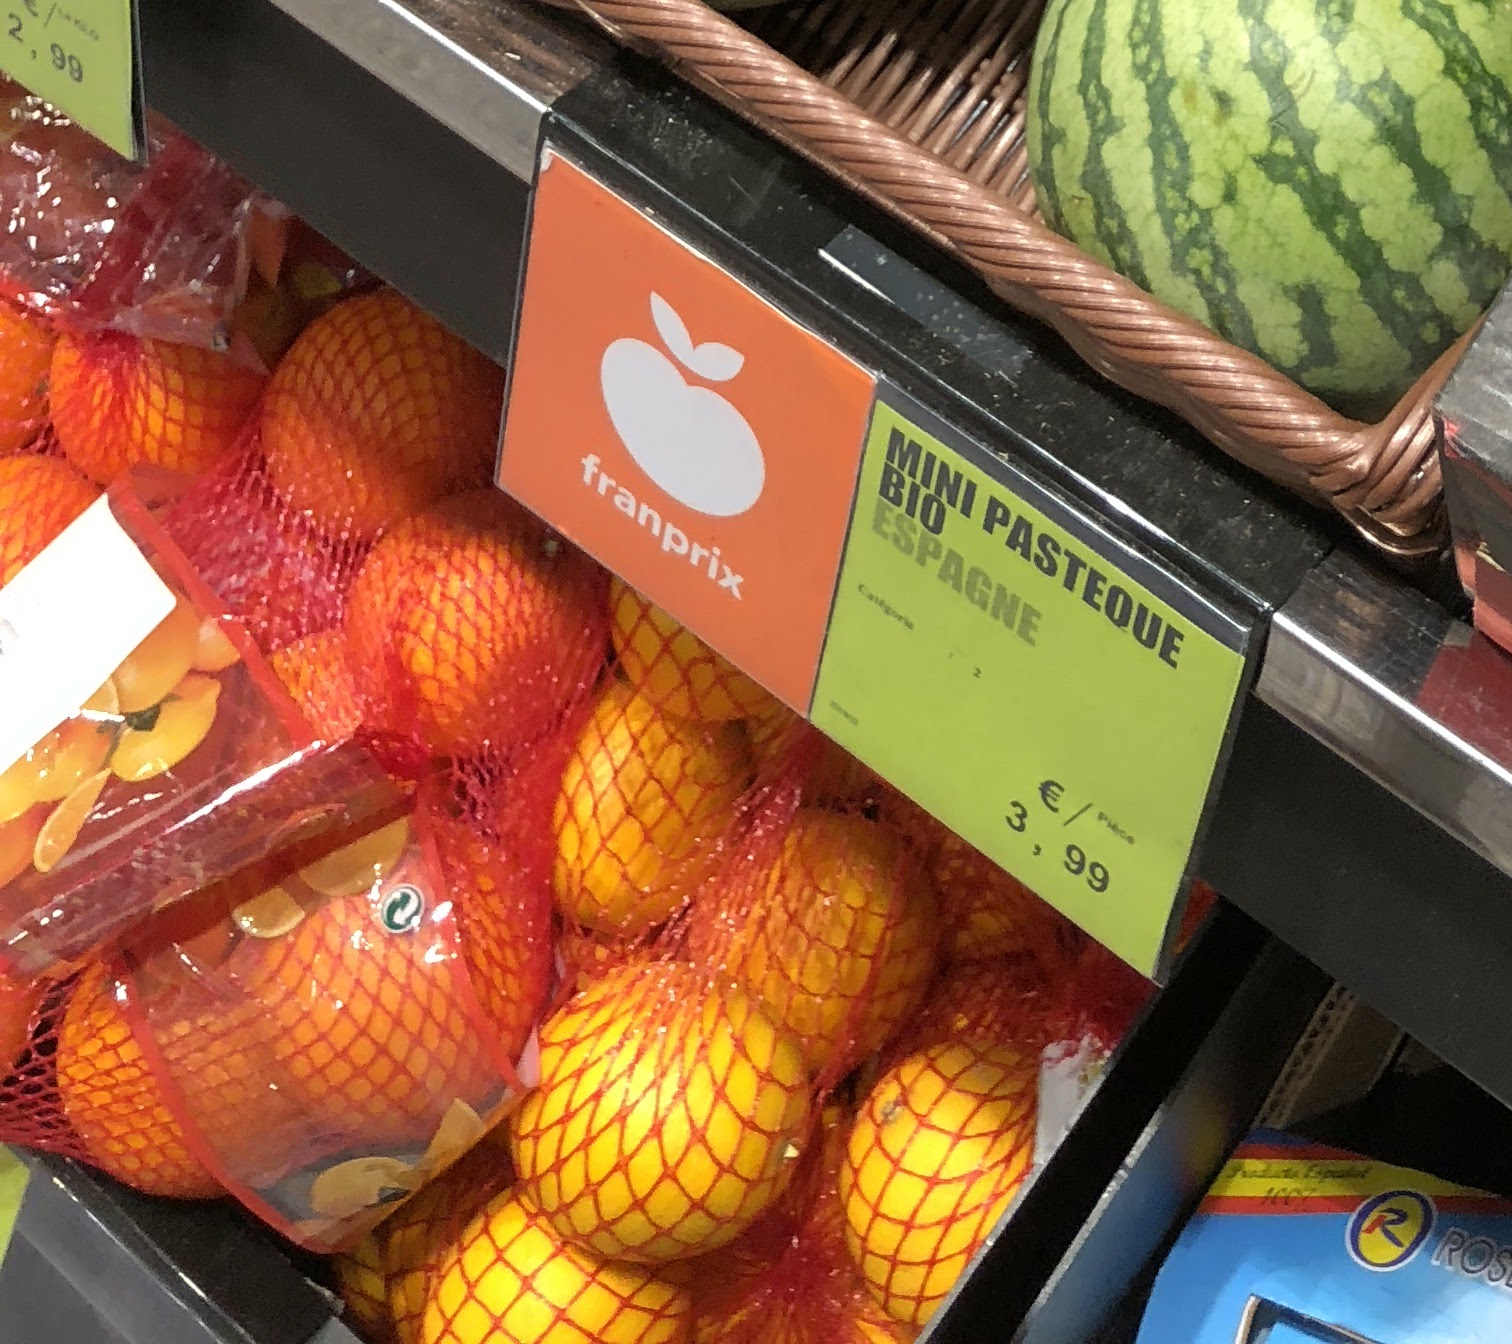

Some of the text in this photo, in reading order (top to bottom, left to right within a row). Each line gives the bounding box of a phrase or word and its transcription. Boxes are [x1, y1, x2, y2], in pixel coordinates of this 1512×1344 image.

[582, 455, 744, 598] franprix
[872, 497, 1042, 647] ESPAGNE
[878, 465, 947, 536] BIO
[886, 427, 1186, 670] MINI PASTEQUE
[1038, 780, 1065, 813] €
